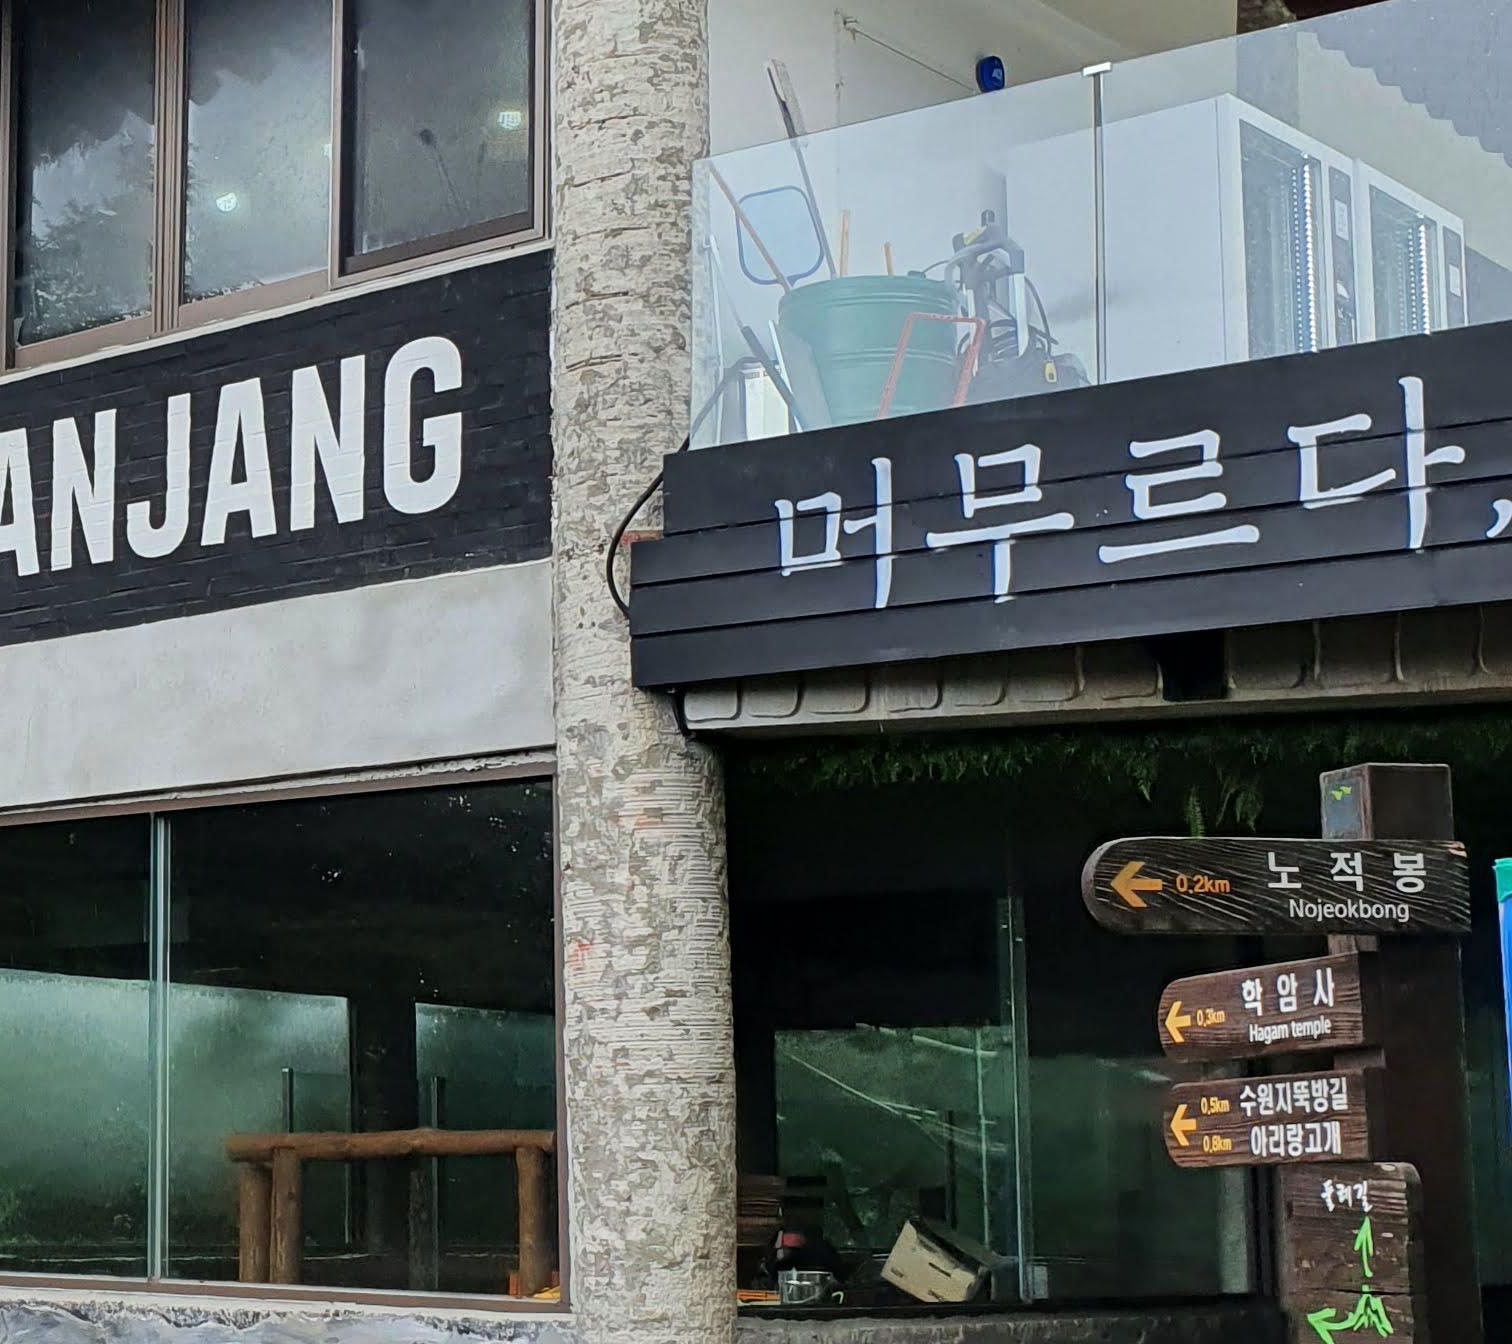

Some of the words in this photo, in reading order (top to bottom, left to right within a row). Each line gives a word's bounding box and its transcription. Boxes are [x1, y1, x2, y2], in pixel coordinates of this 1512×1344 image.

[1176, 873, 1231, 895] 0.2km
[1288, 897, 1410, 923] Nojeokbong
[1196, 1008, 1226, 1028] 0.3km
[1248, 1022, 1290, 1045] Hagam
[1291, 1014, 1333, 1042] temple
[1200, 1096, 1231, 1117] 0.5km
[1239, 1076, 1349, 1117] 수원지뚝방길
[1202, 1134, 1233, 1154] 0.8km
[1250, 1120, 1343, 1158] 아리랑고개
